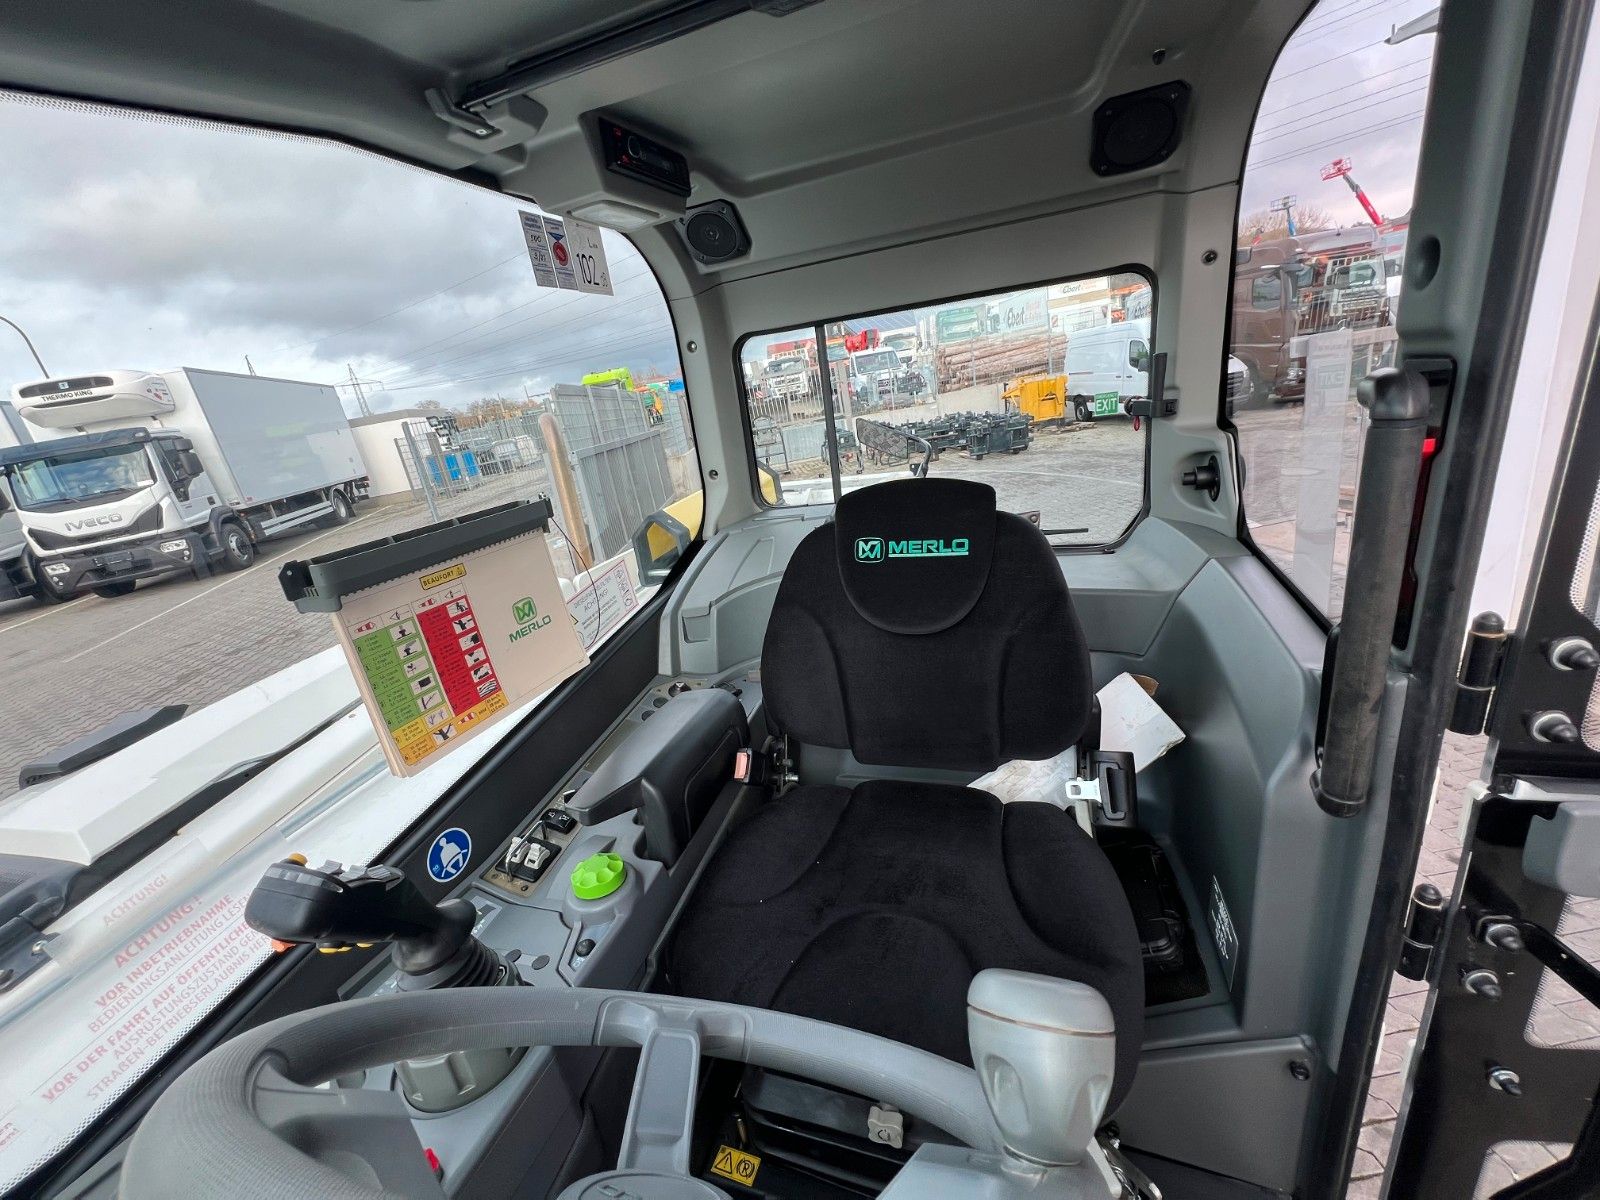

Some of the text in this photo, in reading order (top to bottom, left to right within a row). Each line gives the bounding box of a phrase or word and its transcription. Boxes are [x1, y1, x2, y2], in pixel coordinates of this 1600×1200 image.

[576, 253, 600, 286] 102
[41, 389, 93, 402] THERMO KING
[1096, 398, 1117, 412] EXIT
[64, 512, 123, 532] IVECO
[888, 538, 969, 554] MERLO
[422, 569, 455, 587] BEAUFORT
[508, 614, 552, 643] MERLO
[103, 873, 169, 927] ACHTUNG!
[95, 894, 235, 1009] VOR INBETRIEBNAHME
[114, 901, 194, 969] ACHTUNG
[87, 918, 224, 1034] BEDIENUNGSANLEITUNG
[113, 945, 239, 1061] AUSRÜSTUNGSZUSTAND
[41, 1070, 78, 1104] VOR
[76, 1044, 108, 1074] DER
[107, 1006, 151, 1048] FAHRT
[152, 982, 177, 1010] AUF
